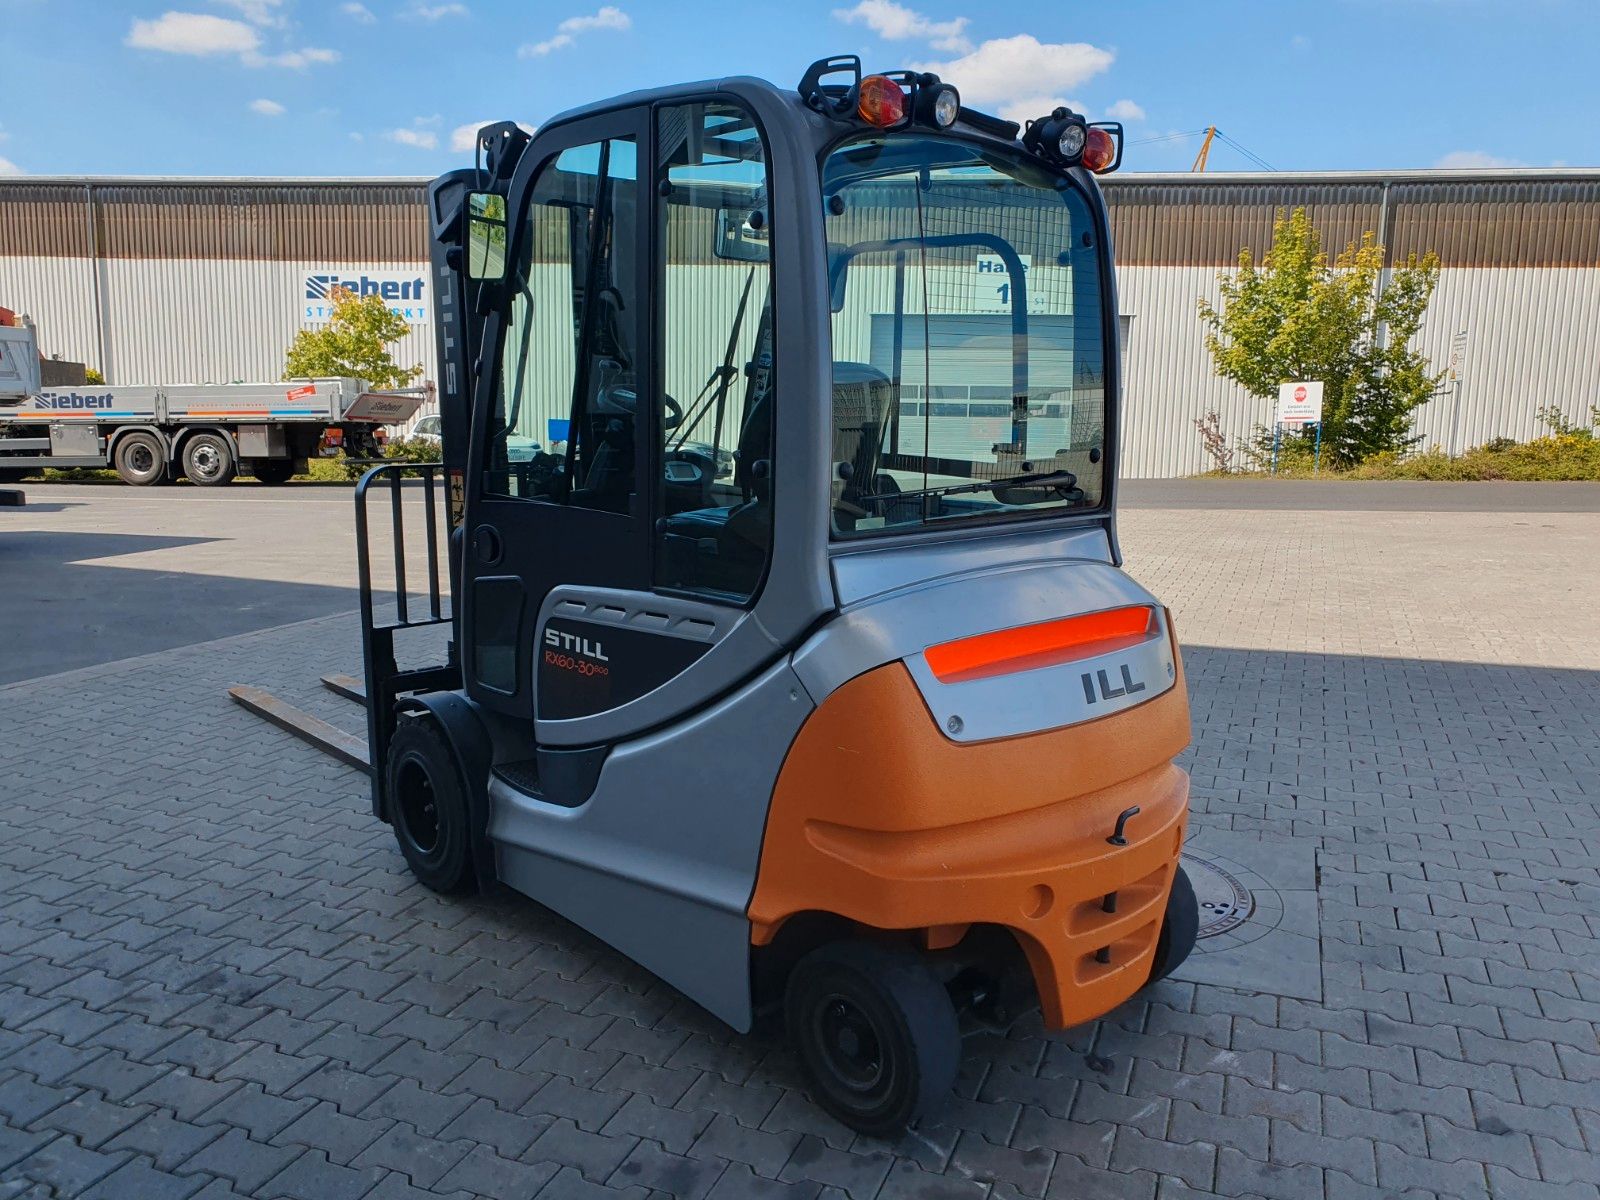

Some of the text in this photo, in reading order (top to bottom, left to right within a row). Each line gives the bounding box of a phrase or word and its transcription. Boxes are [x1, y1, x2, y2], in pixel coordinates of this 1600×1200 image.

[978, 260, 1029, 273] Hae
[997, 283, 1009, 304] 1
[306, 307, 425, 318] STARKT
[35, 393, 113, 408] Siebert
[545, 628, 609, 662] STILL
[1081, 664, 1146, 704] ILL
